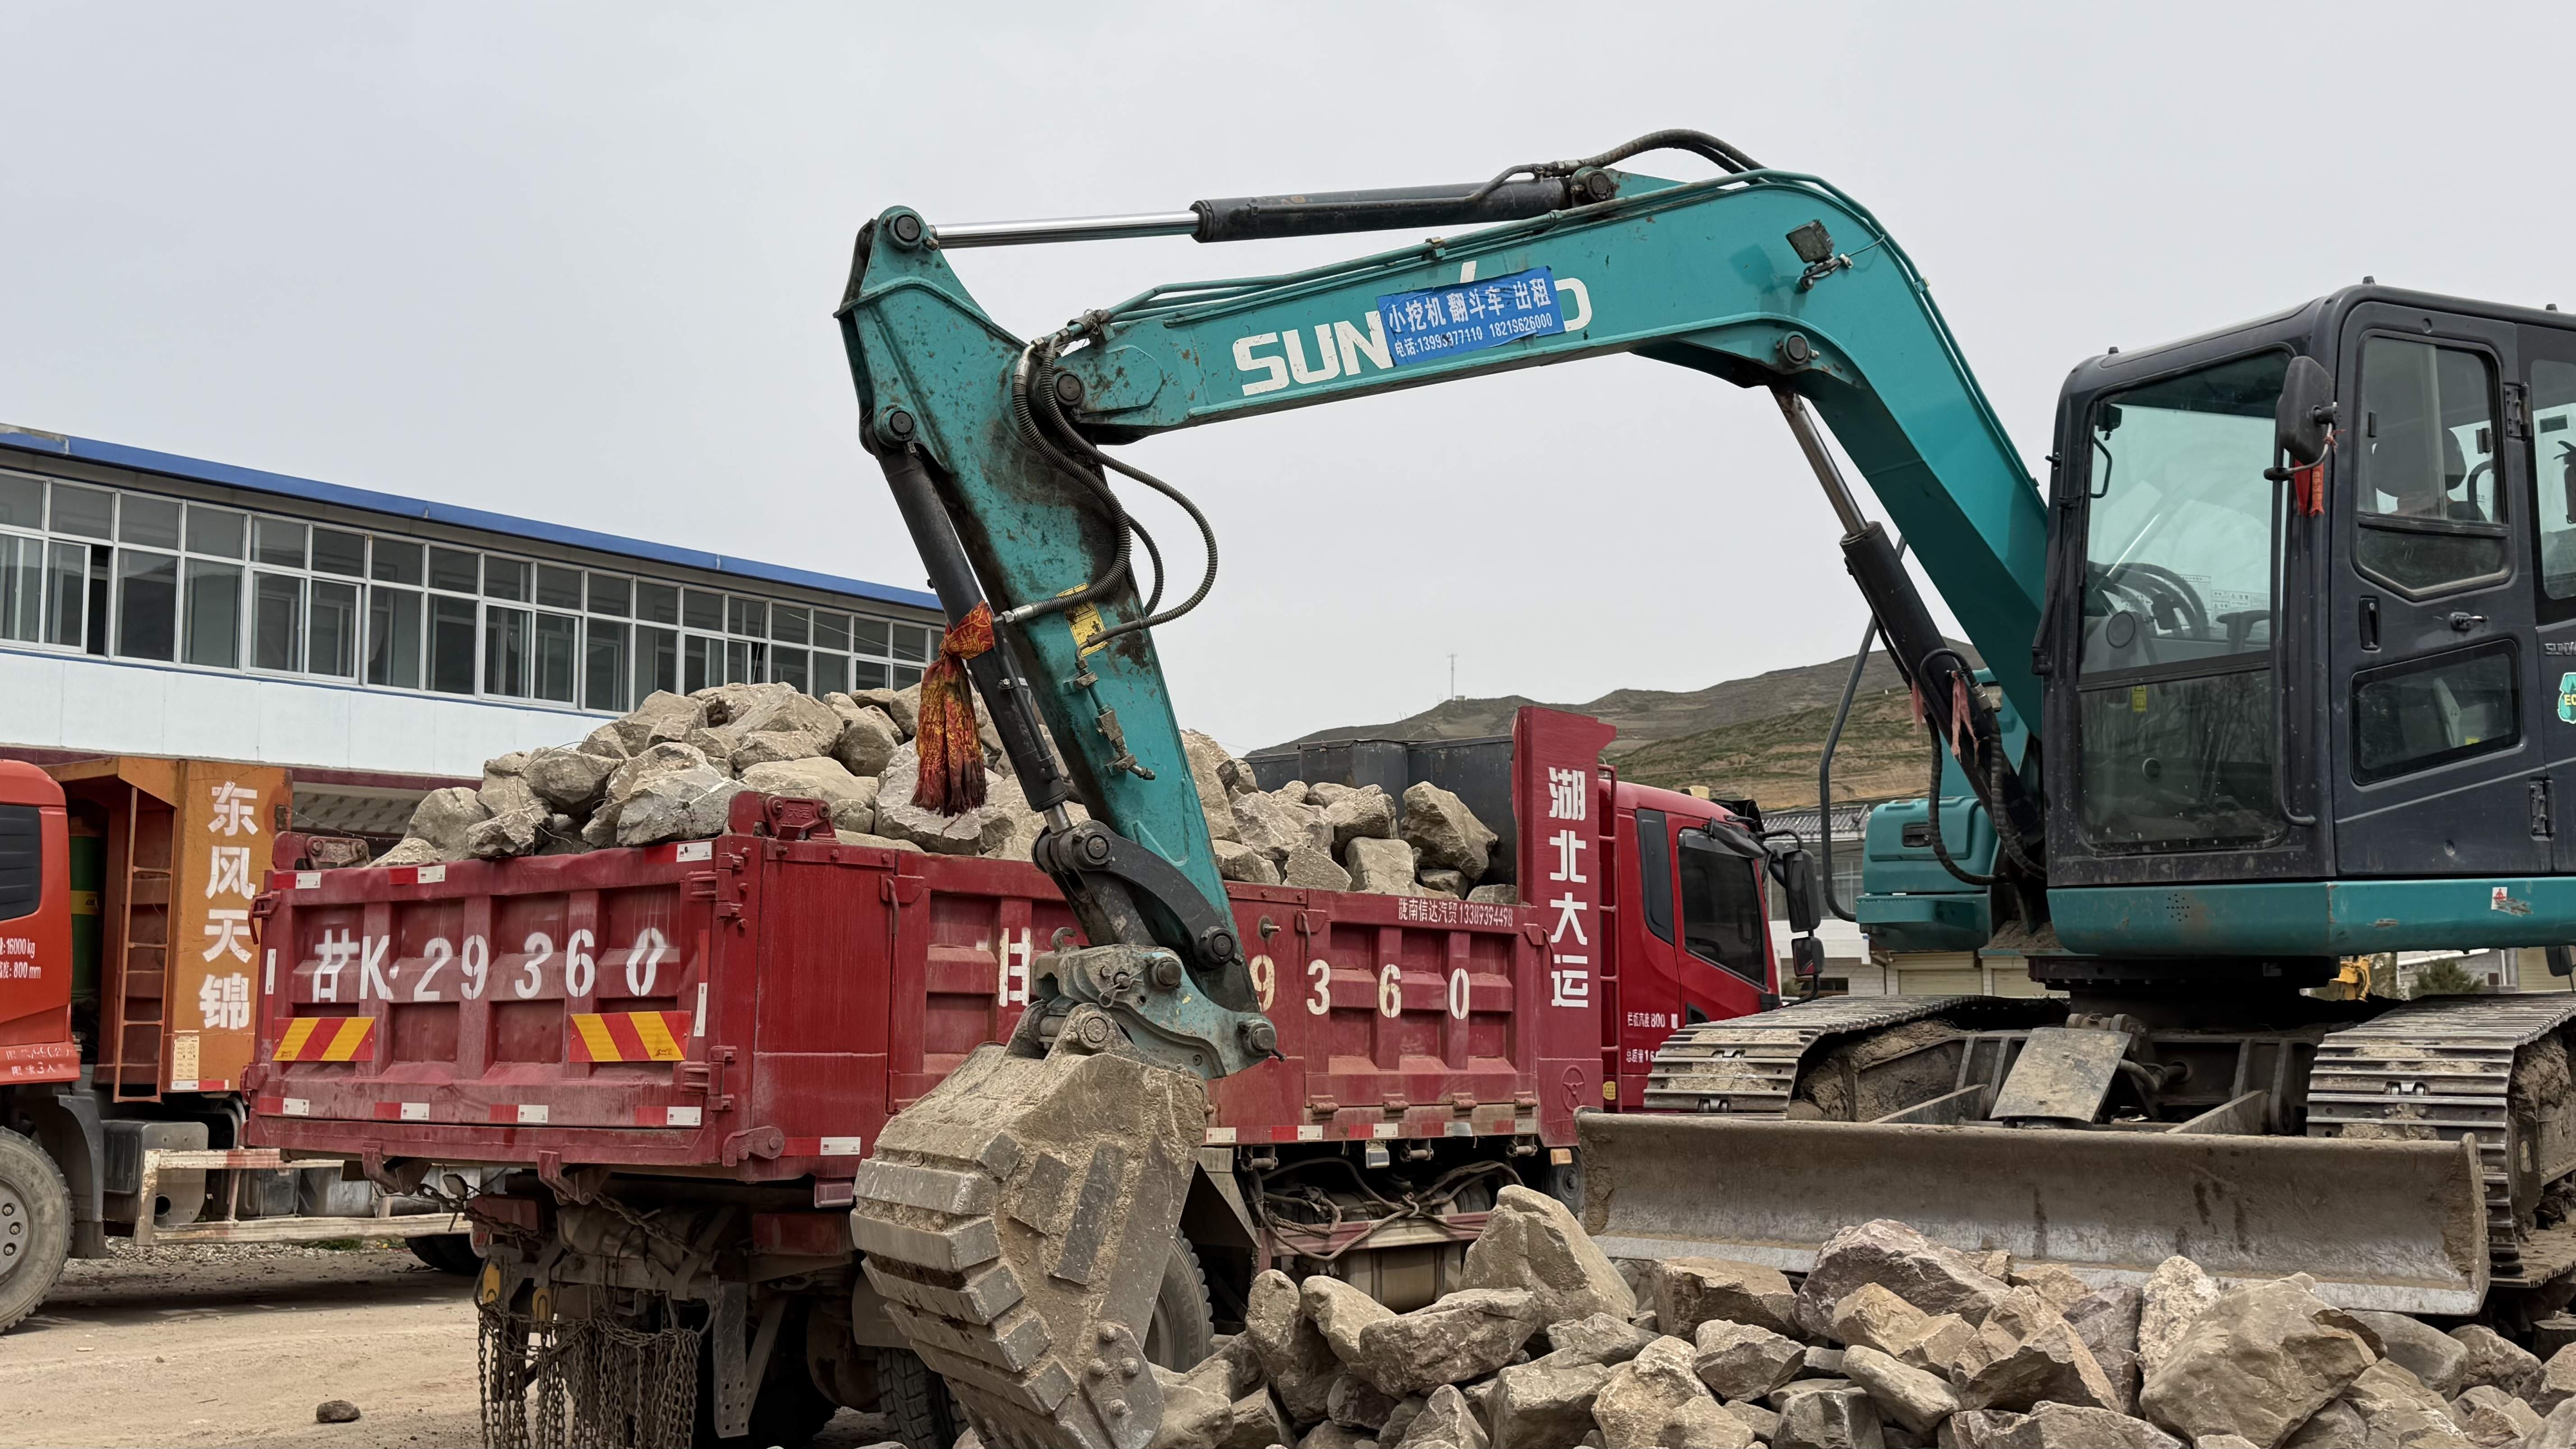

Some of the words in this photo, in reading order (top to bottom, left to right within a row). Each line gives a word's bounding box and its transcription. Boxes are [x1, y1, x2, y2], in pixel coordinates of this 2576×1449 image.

[1389, 297, 1447, 333] 小挖机
[1446, 285, 1505, 324] 翻斗车
[1513, 277, 1552, 310] 出租
[199, 780, 259, 1030] 东风天锦
[1548, 766, 1588, 1008] 湖北大运
